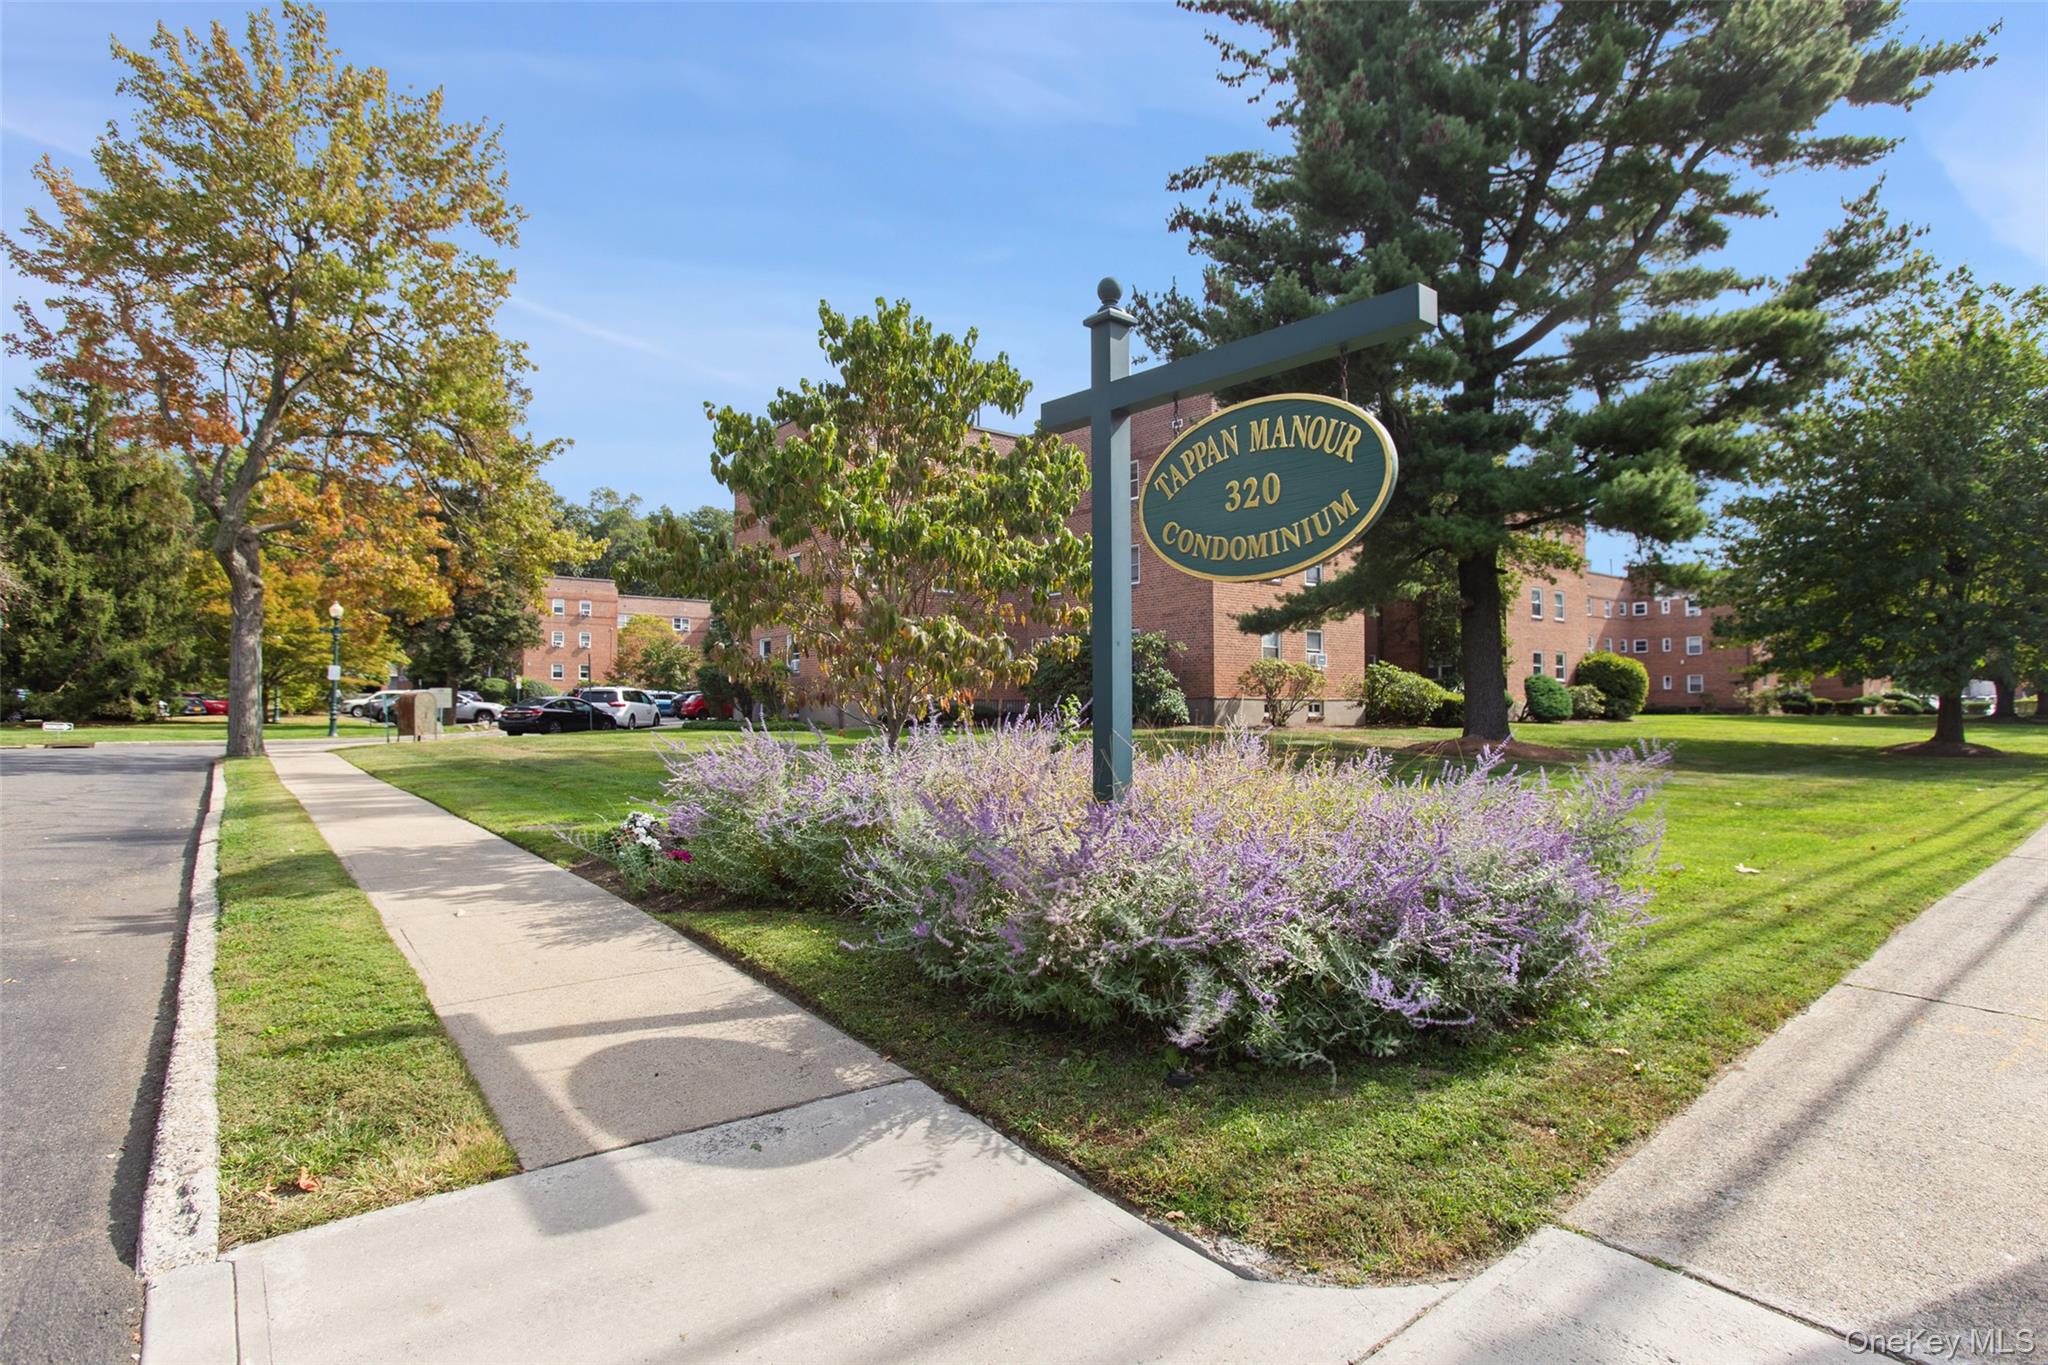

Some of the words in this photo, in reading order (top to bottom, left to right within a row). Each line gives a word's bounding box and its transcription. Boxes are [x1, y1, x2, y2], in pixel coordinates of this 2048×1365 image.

[1154, 425, 1239, 500] TAPPAN
[1249, 415, 1361, 463] MANOUR
[1225, 472, 1281, 512] 320
[1162, 489, 1360, 561] CONDOMINIUM
